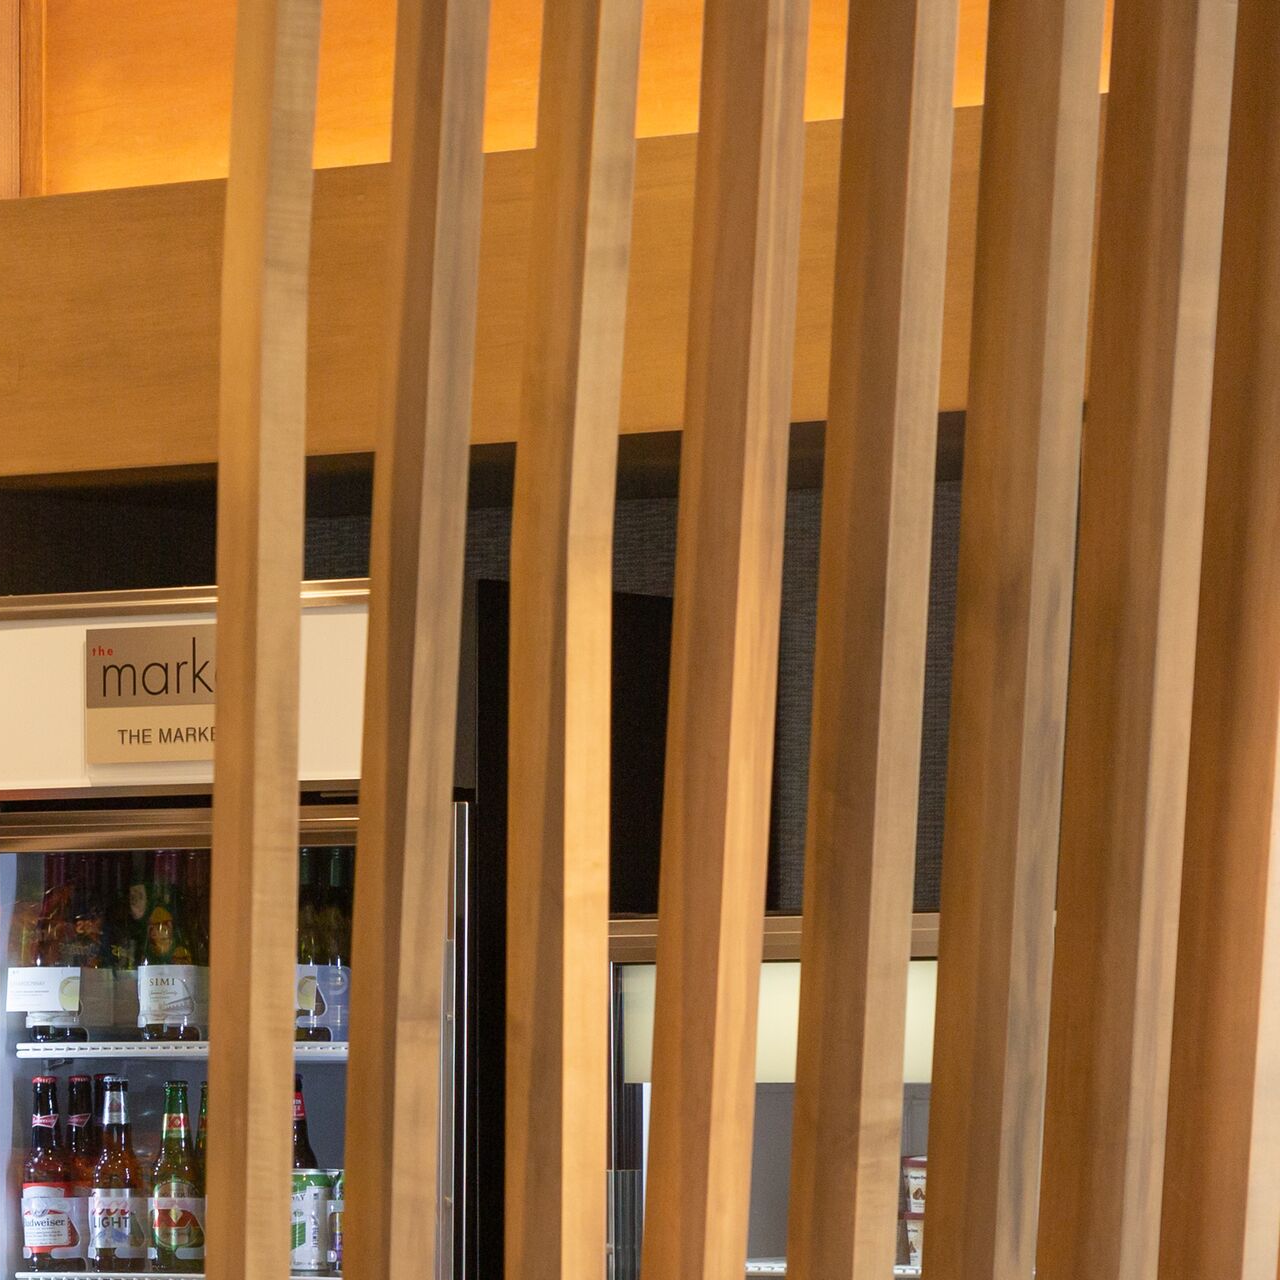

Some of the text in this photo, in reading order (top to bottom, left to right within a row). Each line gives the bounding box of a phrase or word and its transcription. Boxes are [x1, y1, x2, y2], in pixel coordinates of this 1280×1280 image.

[92, 646, 113, 657] the
[102, 637, 217, 697] mark
[118, 726, 216, 745] THE MARKE
[149, 978, 175, 986] SIMI
[93, 1217, 130, 1228] LIGHT
